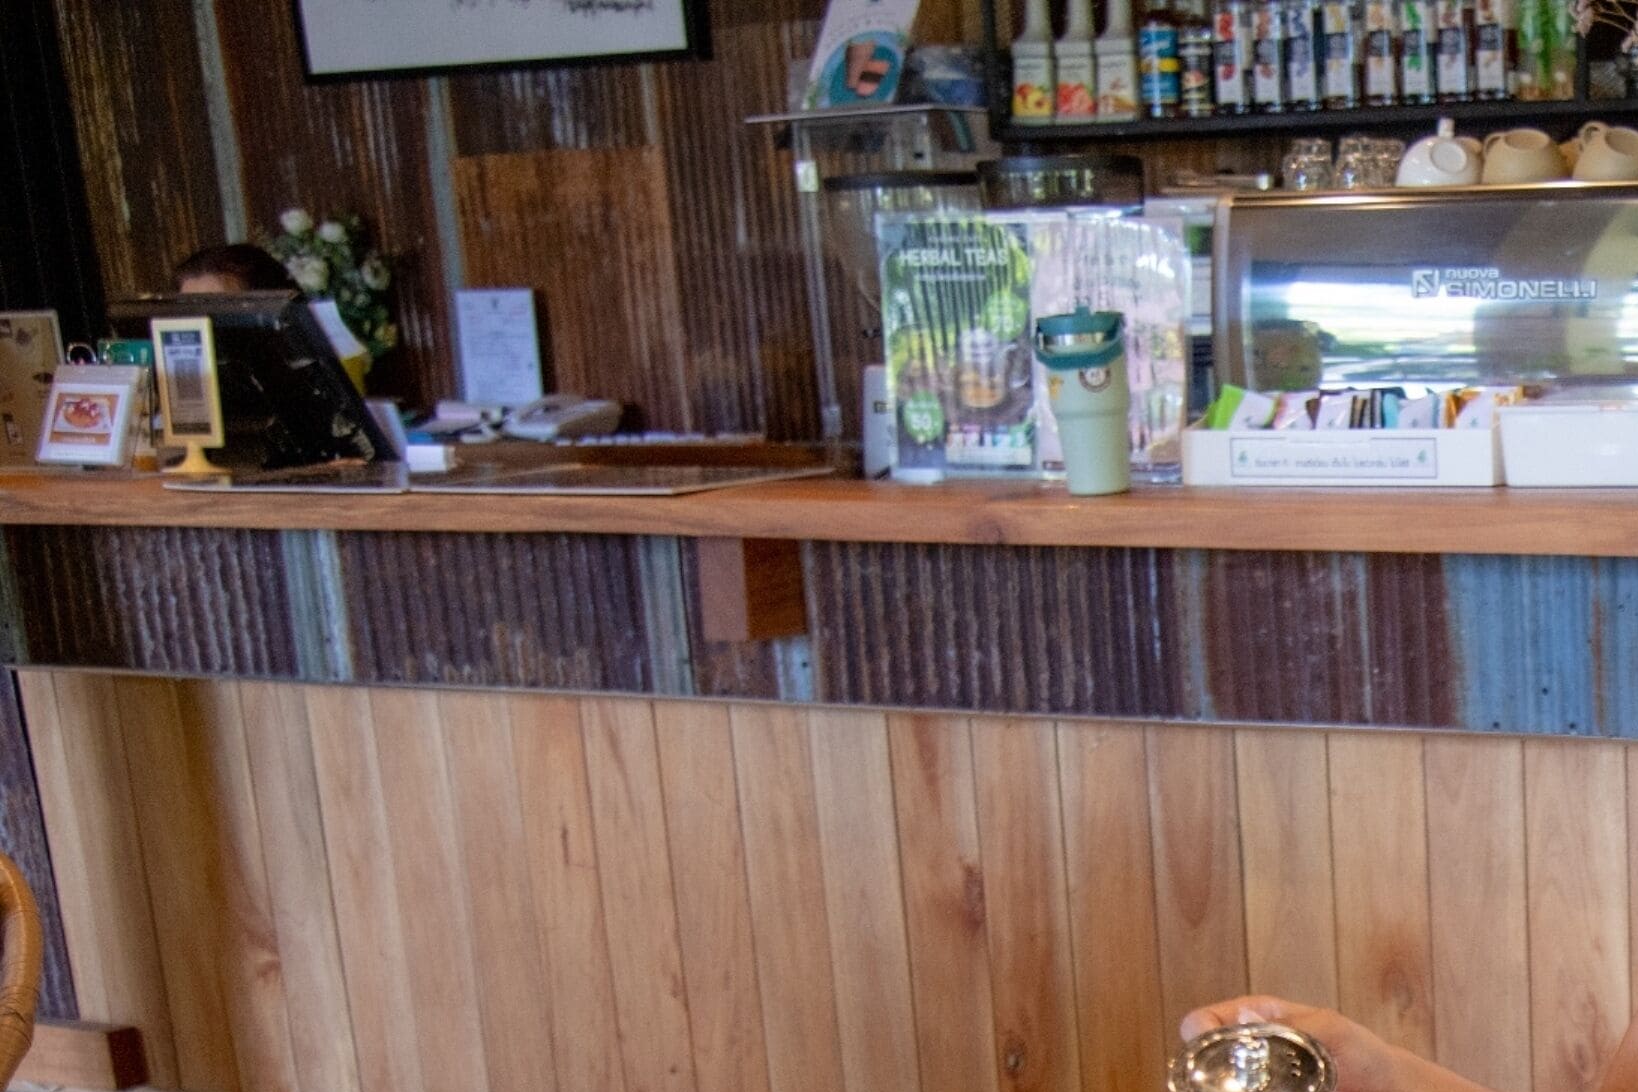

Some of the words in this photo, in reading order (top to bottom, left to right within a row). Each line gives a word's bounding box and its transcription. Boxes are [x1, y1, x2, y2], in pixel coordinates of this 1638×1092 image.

[899, 248, 961, 267] HERBAL
[964, 248, 1008, 267] TEAS
[1445, 267, 1499, 280] nuova
[1445, 280, 1597, 300] SIMONELLI
